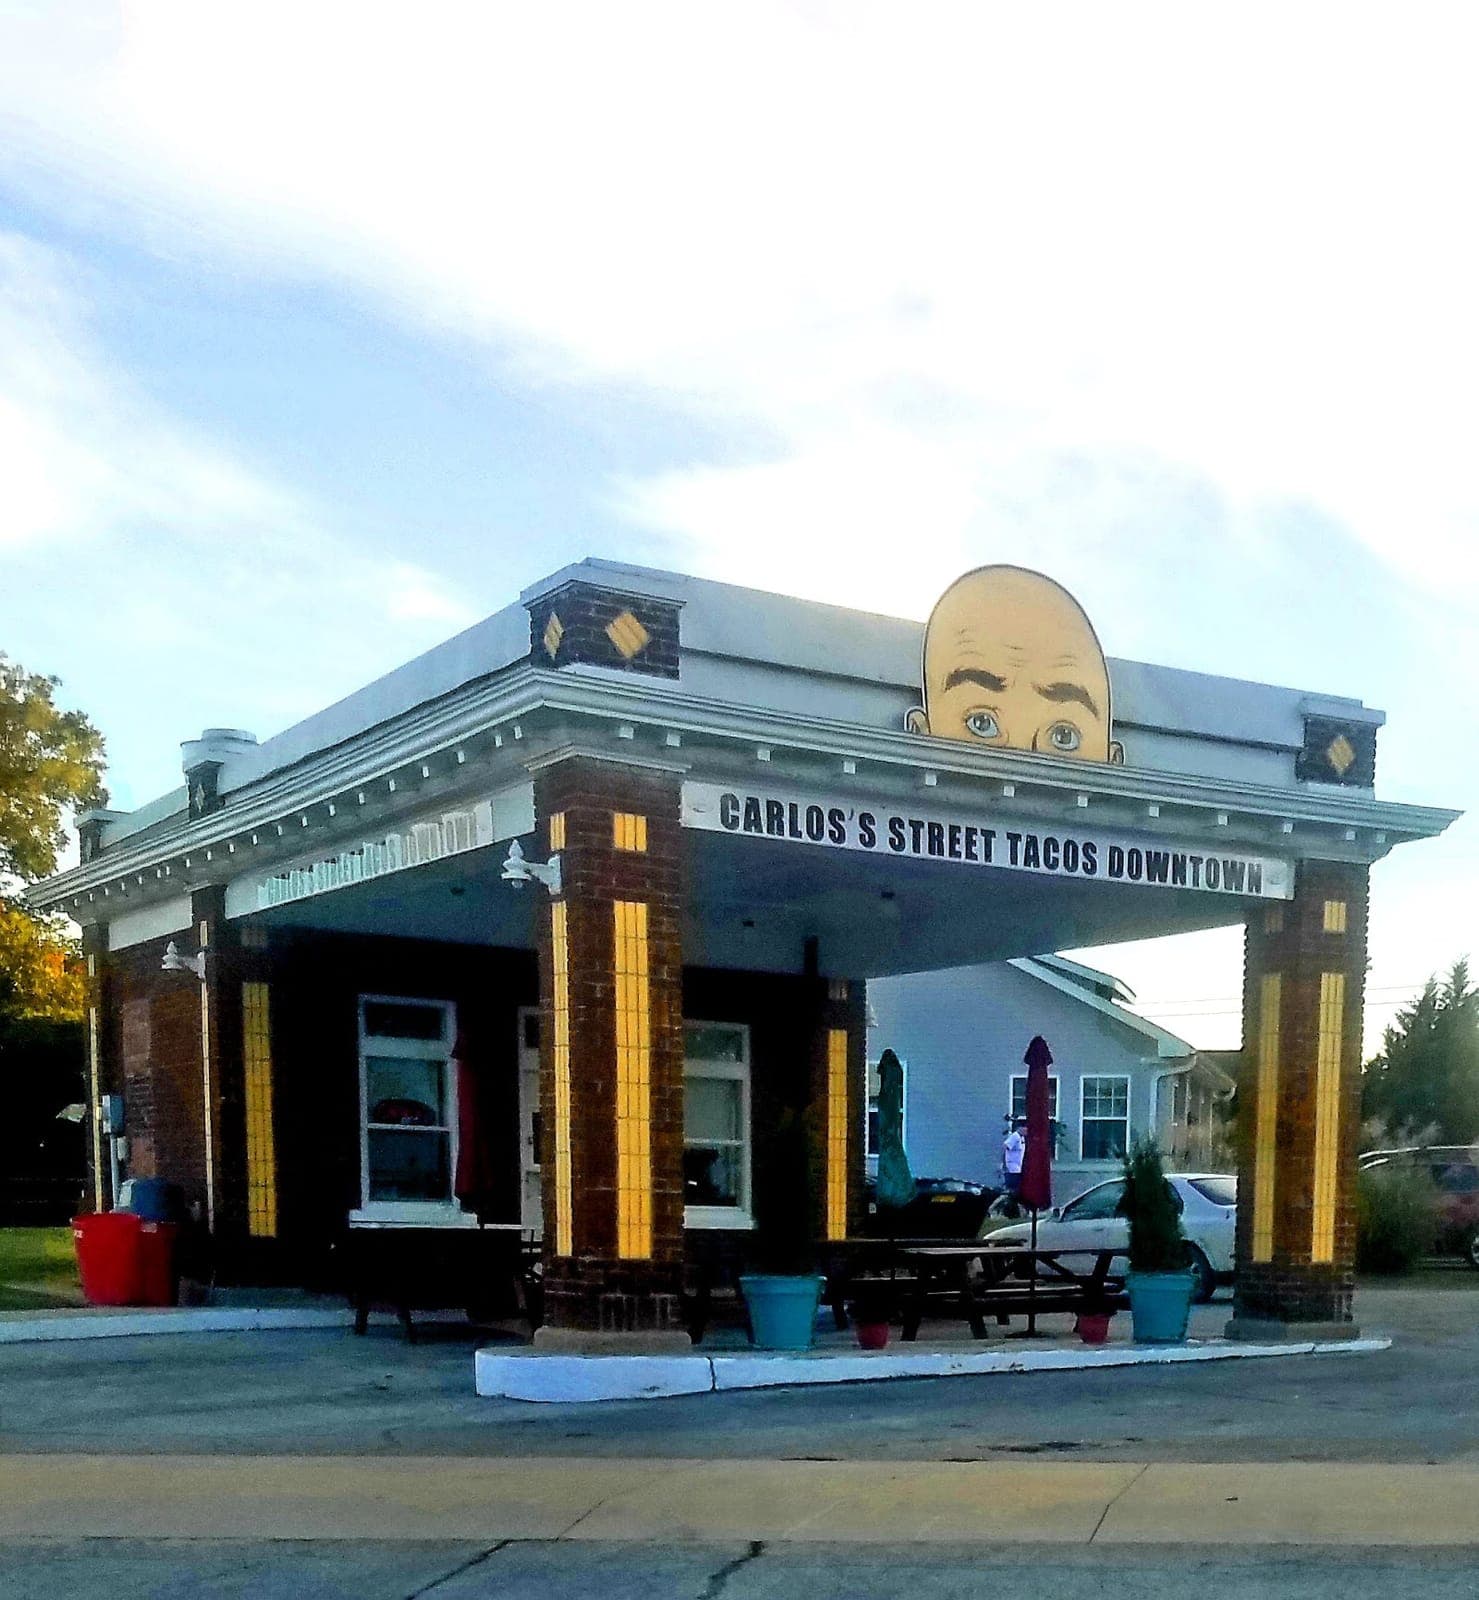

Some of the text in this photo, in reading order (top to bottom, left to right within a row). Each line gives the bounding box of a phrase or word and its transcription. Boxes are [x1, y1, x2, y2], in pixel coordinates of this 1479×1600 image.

[719, 793, 1263, 894] CARLOS'S STREET TACOS DOWNTOWN
